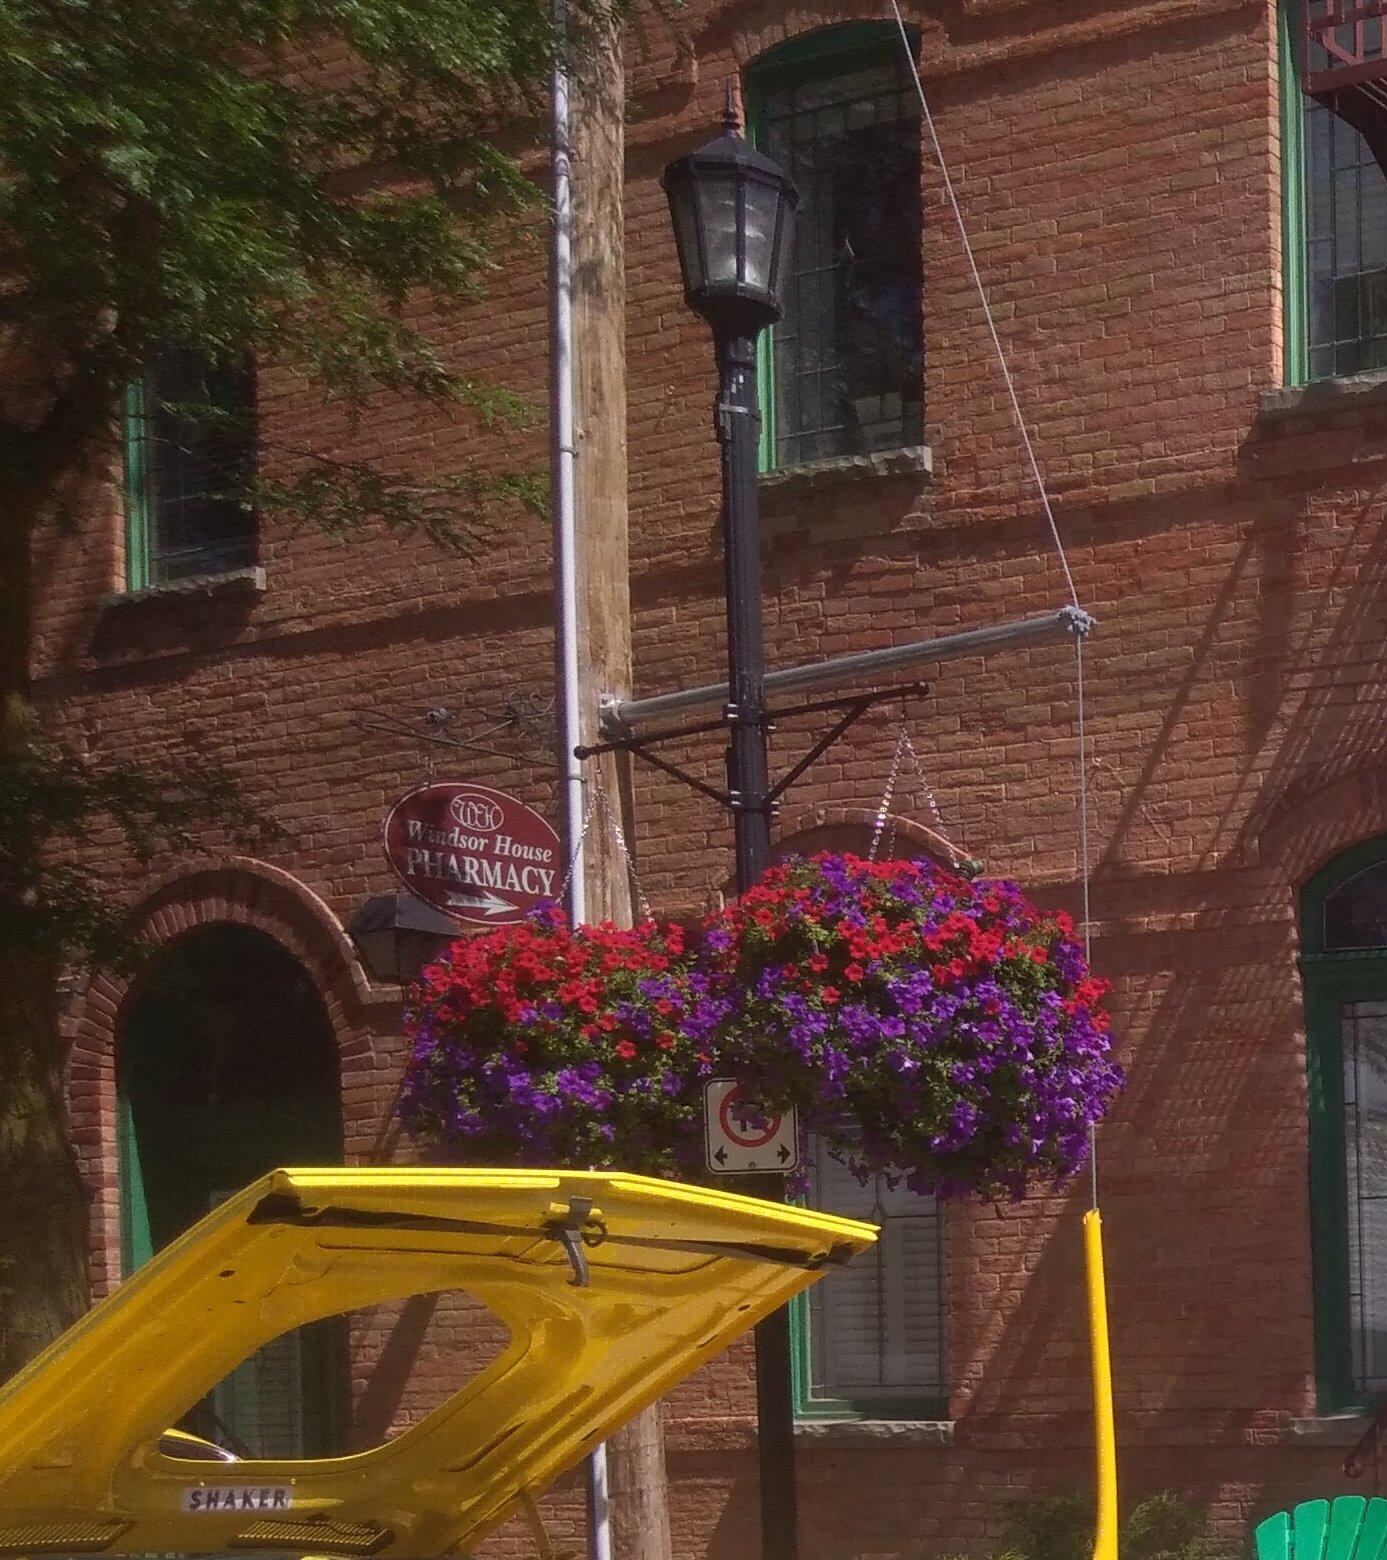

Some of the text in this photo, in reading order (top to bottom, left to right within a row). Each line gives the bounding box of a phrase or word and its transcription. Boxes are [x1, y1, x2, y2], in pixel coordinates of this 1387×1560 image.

[408, 820, 553, 863] Windsor House
[406, 848, 556, 897] PHARMACY
[189, 1488, 289, 1510] SHAKER
